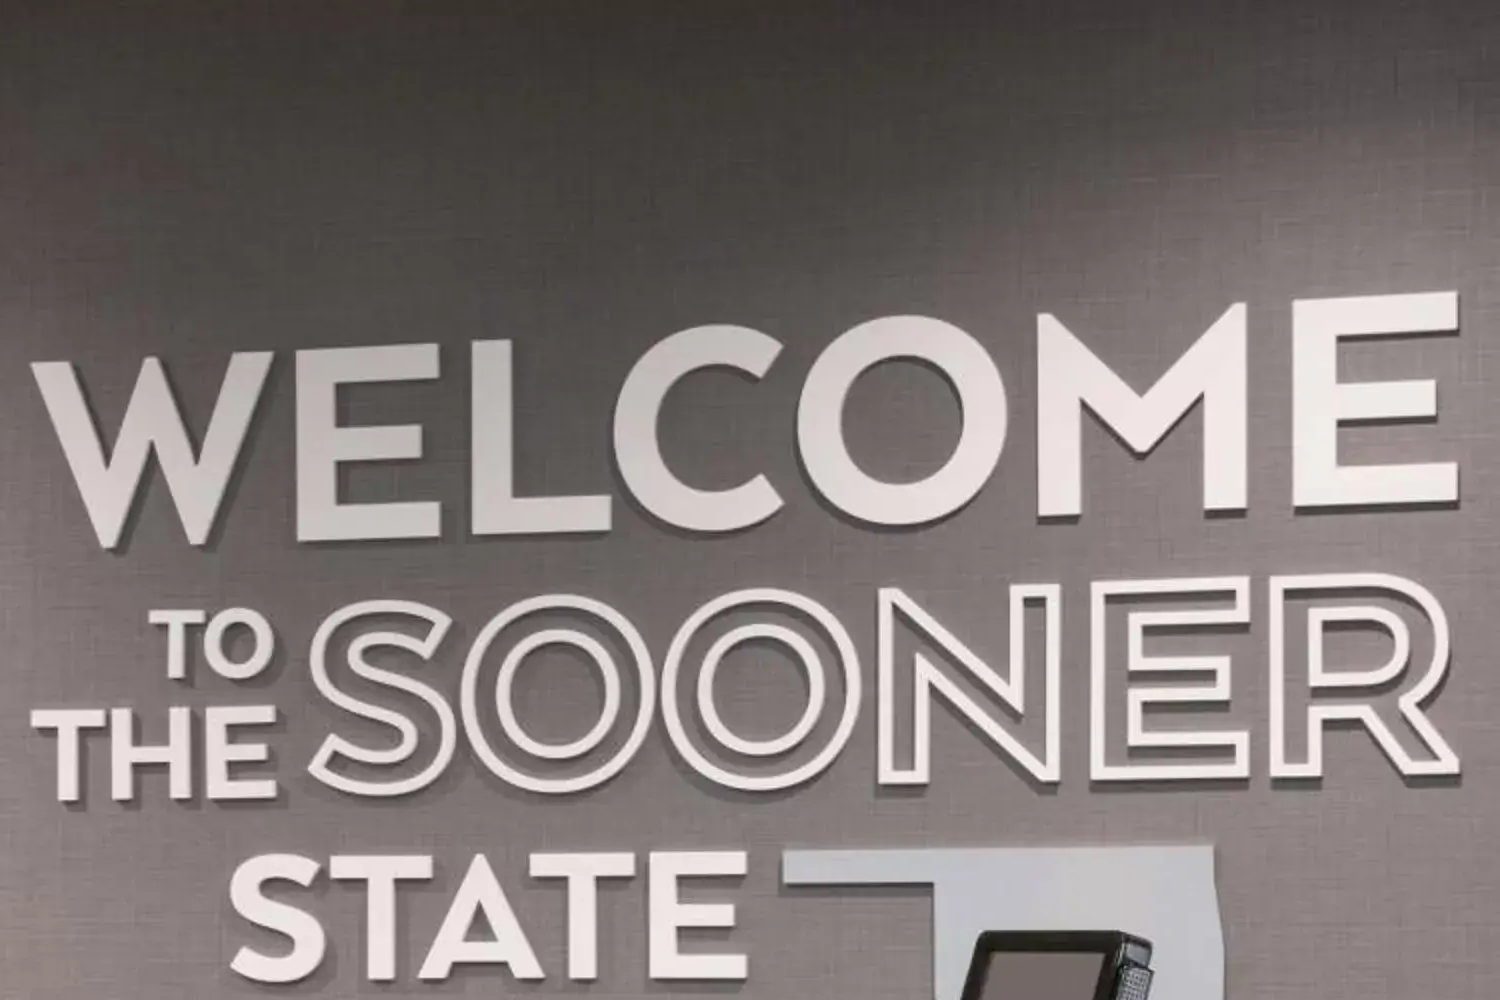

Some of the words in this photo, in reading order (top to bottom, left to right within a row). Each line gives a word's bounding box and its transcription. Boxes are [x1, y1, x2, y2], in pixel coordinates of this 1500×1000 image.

[30, 290, 1460, 549] WELCOME
[30, 704, 277, 801] THE
[308, 572, 1461, 797] SOONER
[148, 607, 275, 680] TO
[229, 852, 749, 983] STATE
